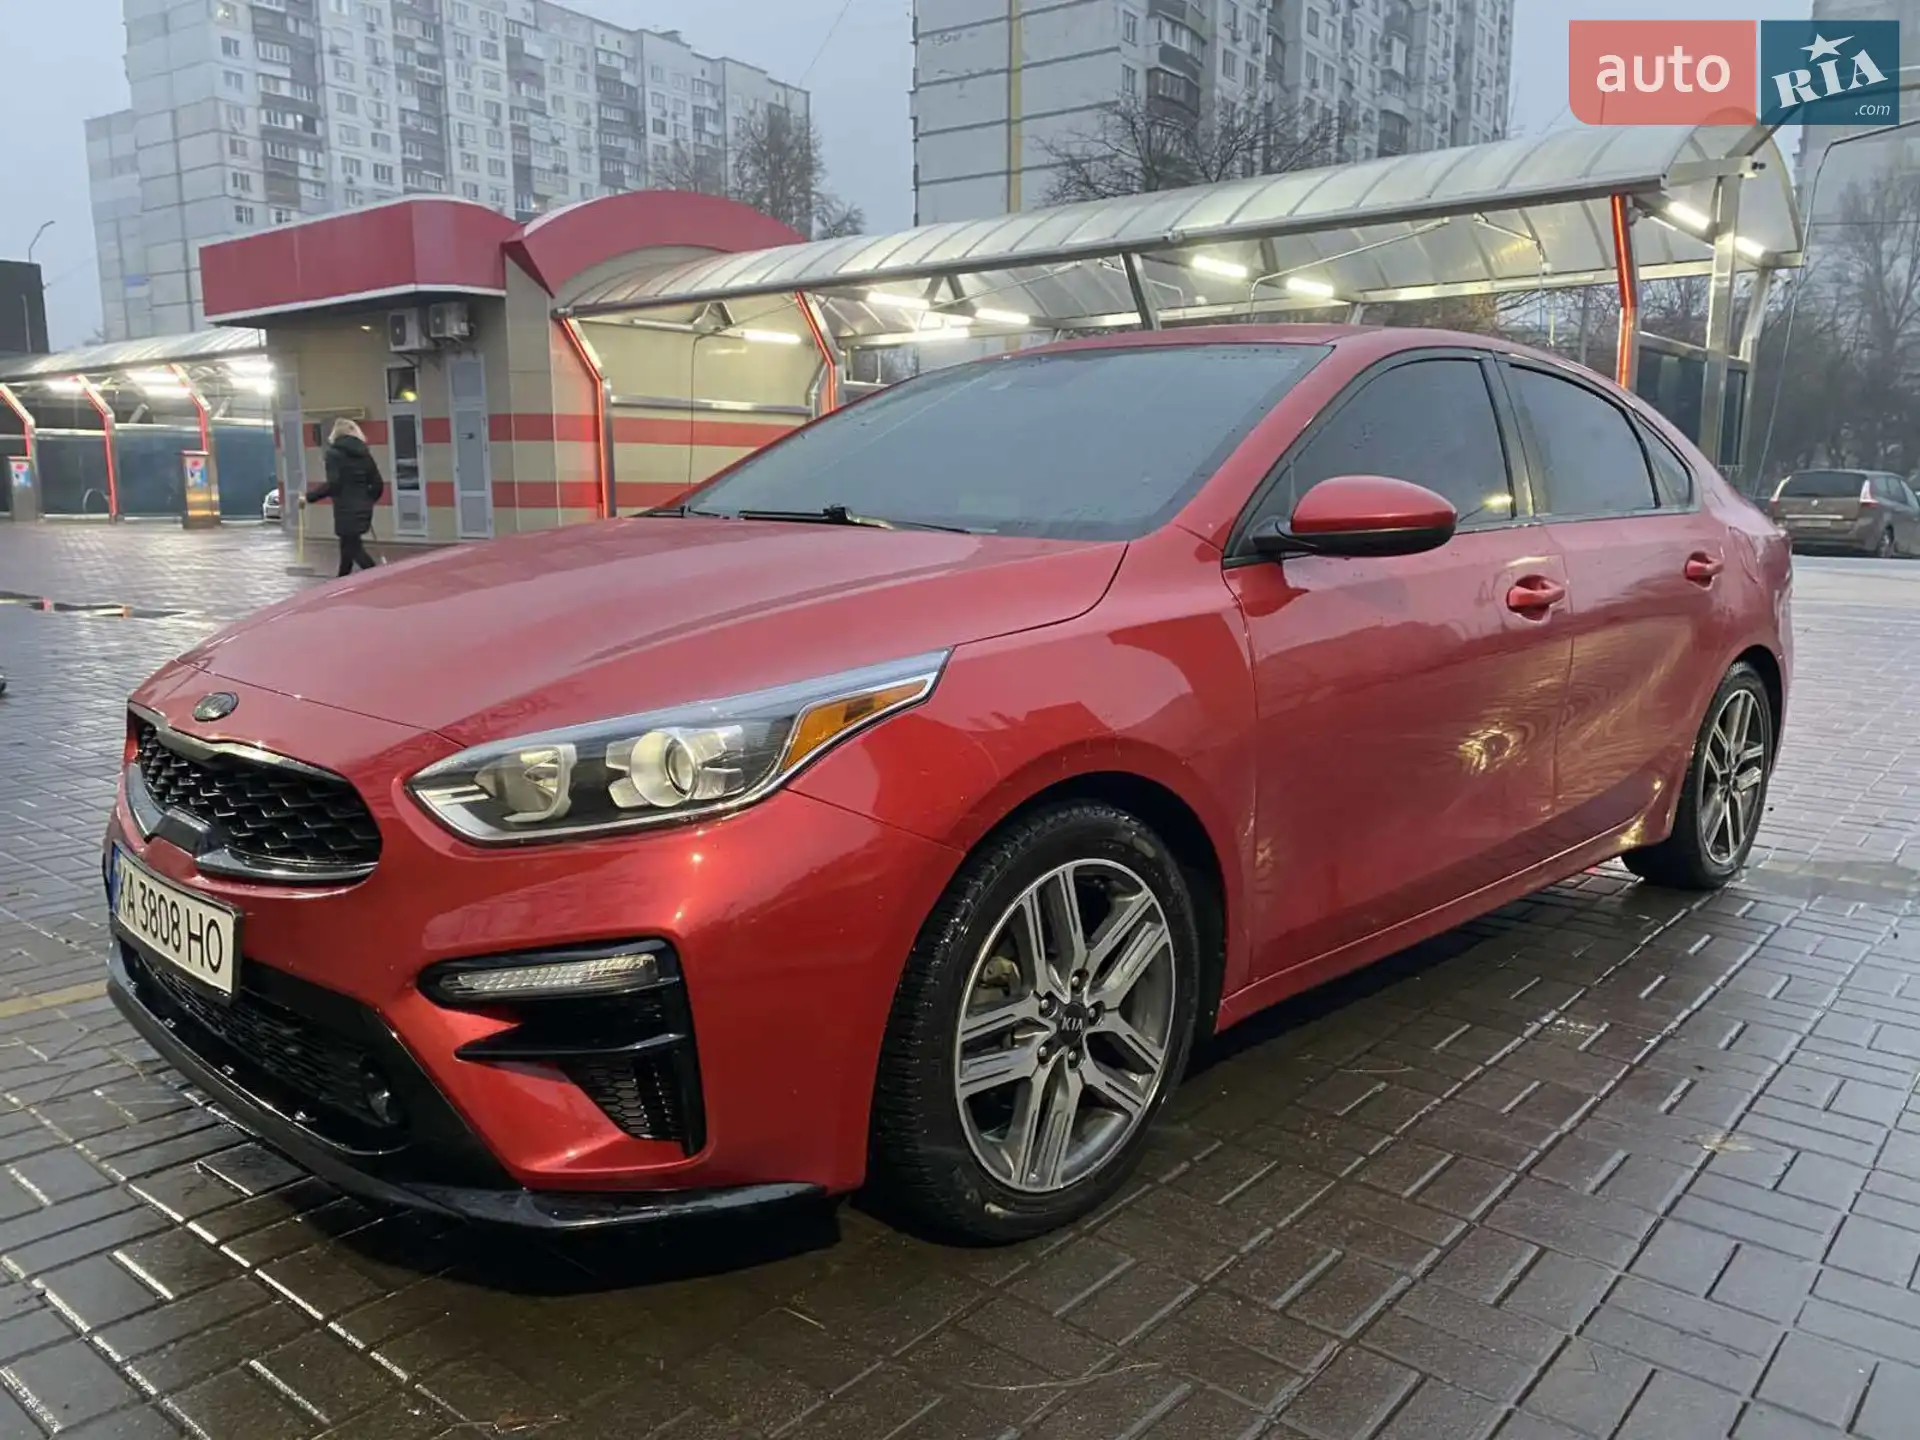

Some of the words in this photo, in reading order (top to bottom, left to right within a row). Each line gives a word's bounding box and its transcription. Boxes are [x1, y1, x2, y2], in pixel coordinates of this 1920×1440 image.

[138, 881, 181, 954] 3808
[186, 907, 223, 974] HO
[1061, 1016, 1082, 1031] KIA
